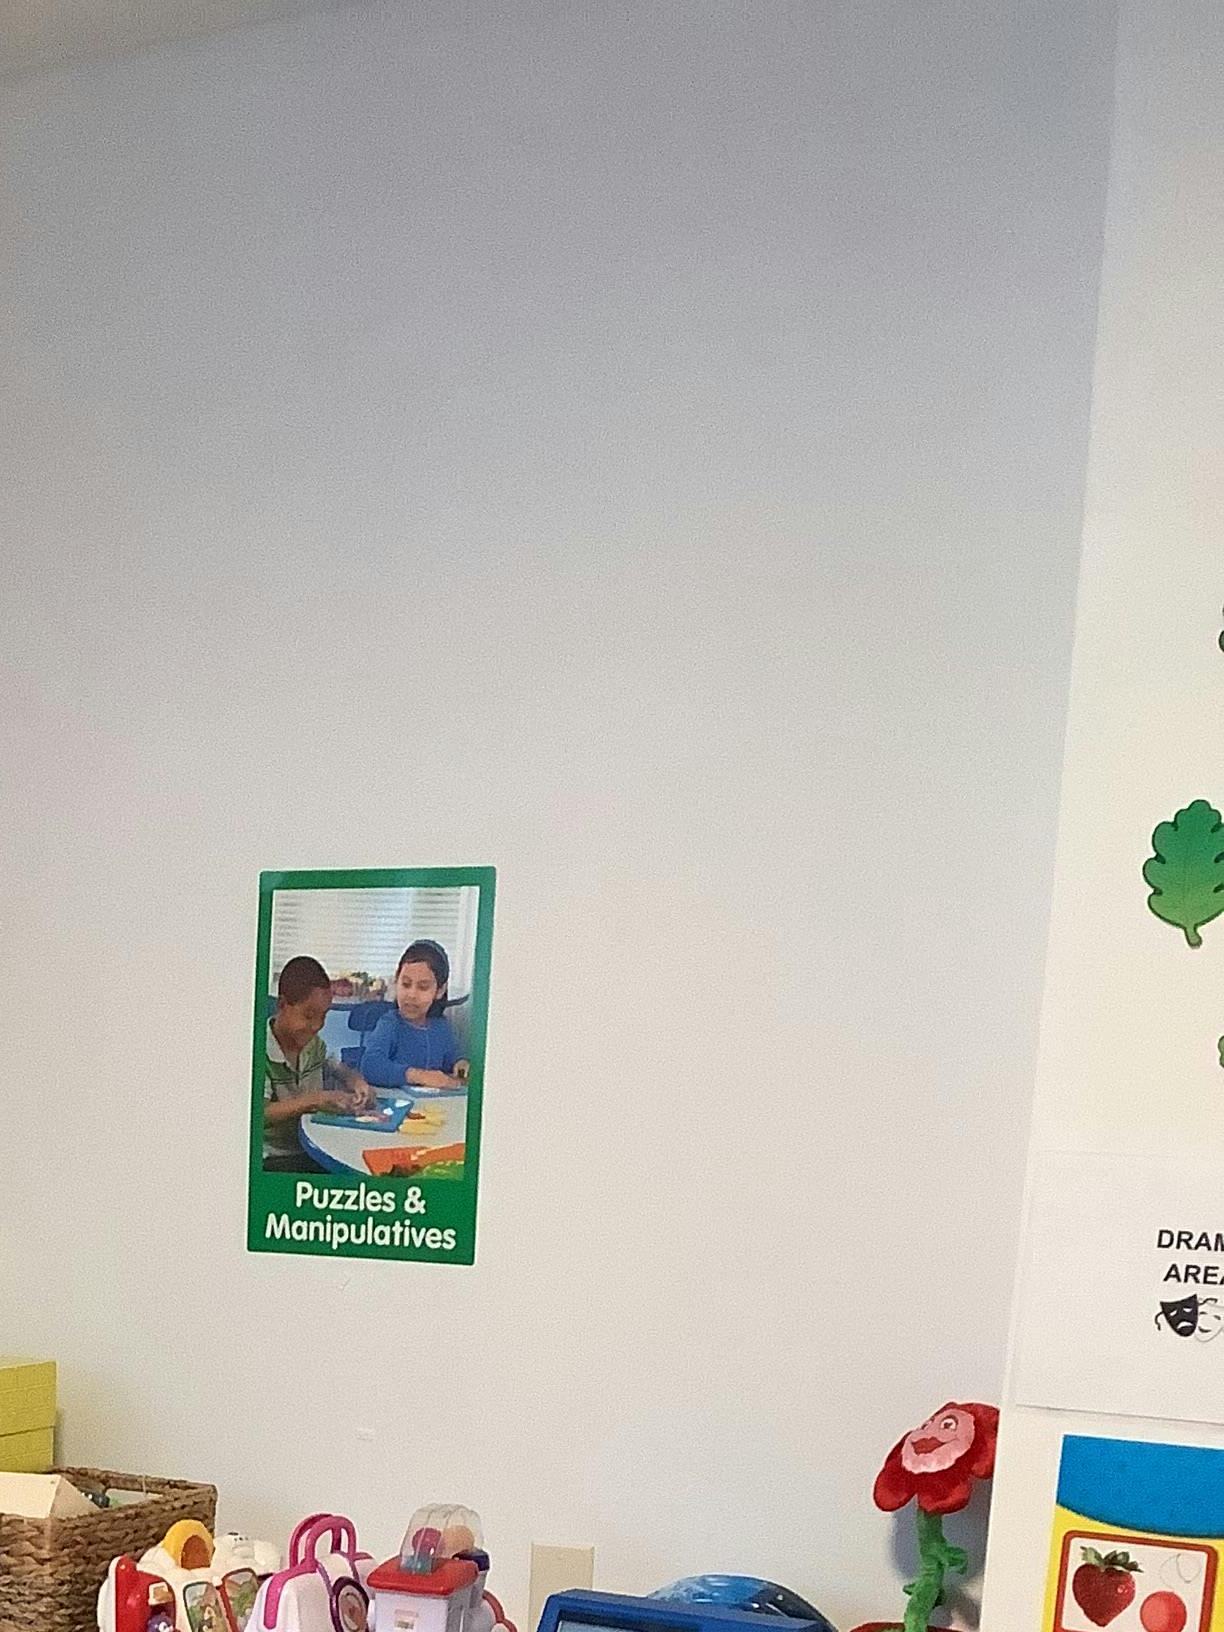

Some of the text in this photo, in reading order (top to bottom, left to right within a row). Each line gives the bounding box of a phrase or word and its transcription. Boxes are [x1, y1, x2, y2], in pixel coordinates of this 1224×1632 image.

[295, 1181, 426, 1214] Puzzles &
[264, 1212, 457, 1250] Manipulatives
